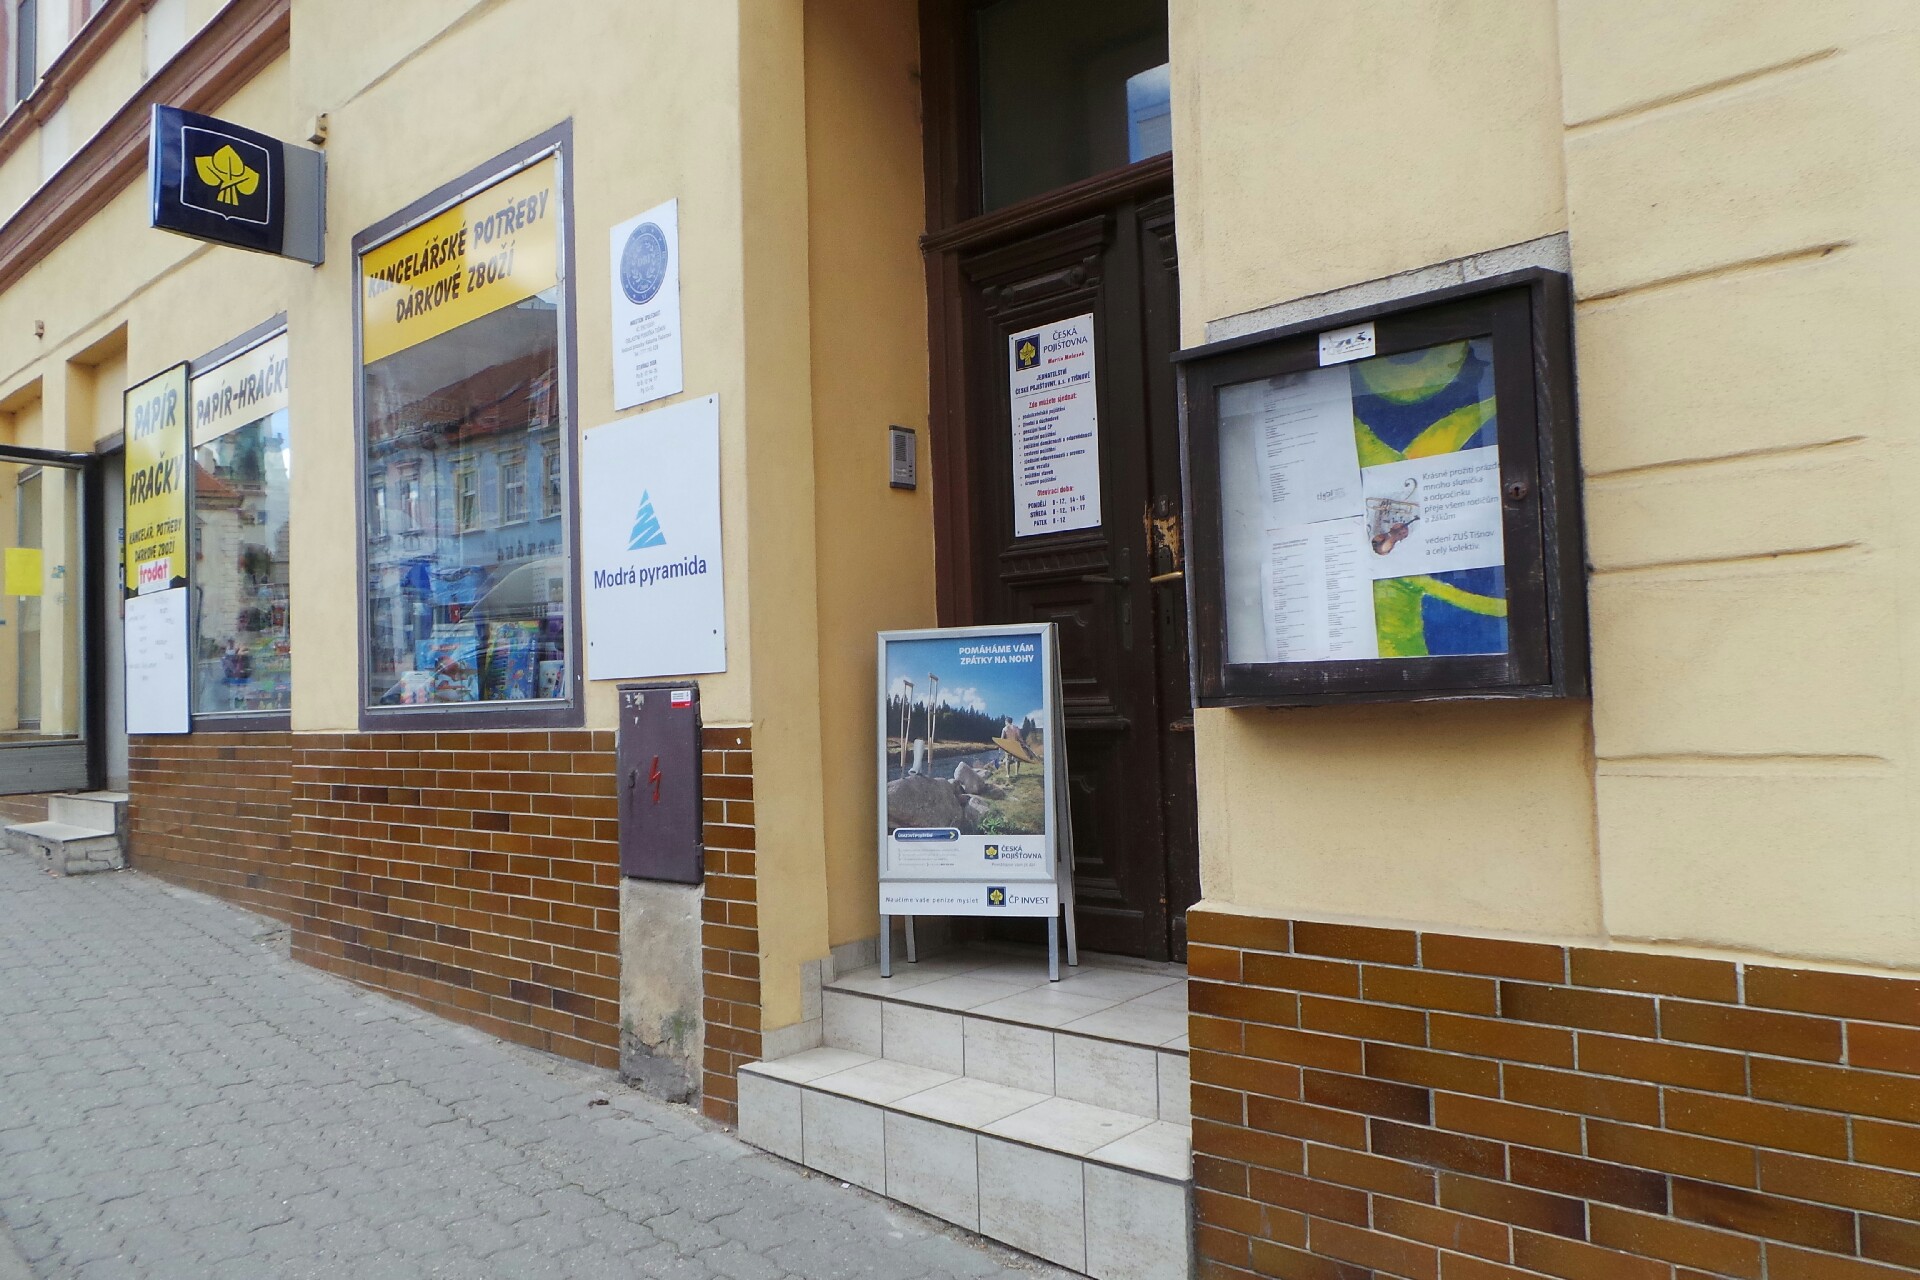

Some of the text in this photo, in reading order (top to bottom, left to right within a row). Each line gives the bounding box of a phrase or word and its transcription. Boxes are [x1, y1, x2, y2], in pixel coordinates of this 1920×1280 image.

[368, 188, 550, 299] KANCELÁŘSKÉ POTŘEBY
[396, 239, 516, 323] DÁRKOVÉ ZBOŽÍ
[1053, 326, 1077, 341] ČESKÁ
[1028, 400, 1038, 409] Zde
[1038, 397, 1056, 406] můžete
[133, 384, 179, 441] PAPÍR
[129, 451, 185, 506] HRAČKY
[1422, 471, 1448, 481] Krásné
[1423, 475, 1484, 491] mnoho sluníčka
[1429, 488, 1471, 502] odpočinku
[1027, 499, 1047, 510] PONDĚLÍ
[1424, 494, 1499, 515] přeje všem rodičům
[1029, 508, 1047, 519] STŘEDA
[1059, 516, 1066, 524] 12
[1430, 512, 1456, 523] žákům
[156, 517, 183, 537] POTŘEBY
[1424, 528, 1495, 545] vedení ZUŠ Tišnov
[158, 536, 176, 557] ZBOŽÍ
[1432, 545, 1448, 556] celý
[139, 558, 168, 585] trodat
[594, 555, 707, 589] Modrá pyramida
[959, 642, 1034, 655] POMÁHÁME VÁM
[960, 654, 1034, 665] ZPÁTKY NA NOHY
[1001, 844, 1022, 852] ČESKÁ
[1001, 851, 1042, 860] POJIŠŤOVNA
[885, 896, 979, 906] Naučíme vaše peníze myslet
[1008, 894, 1050, 905] ČP INVEST
